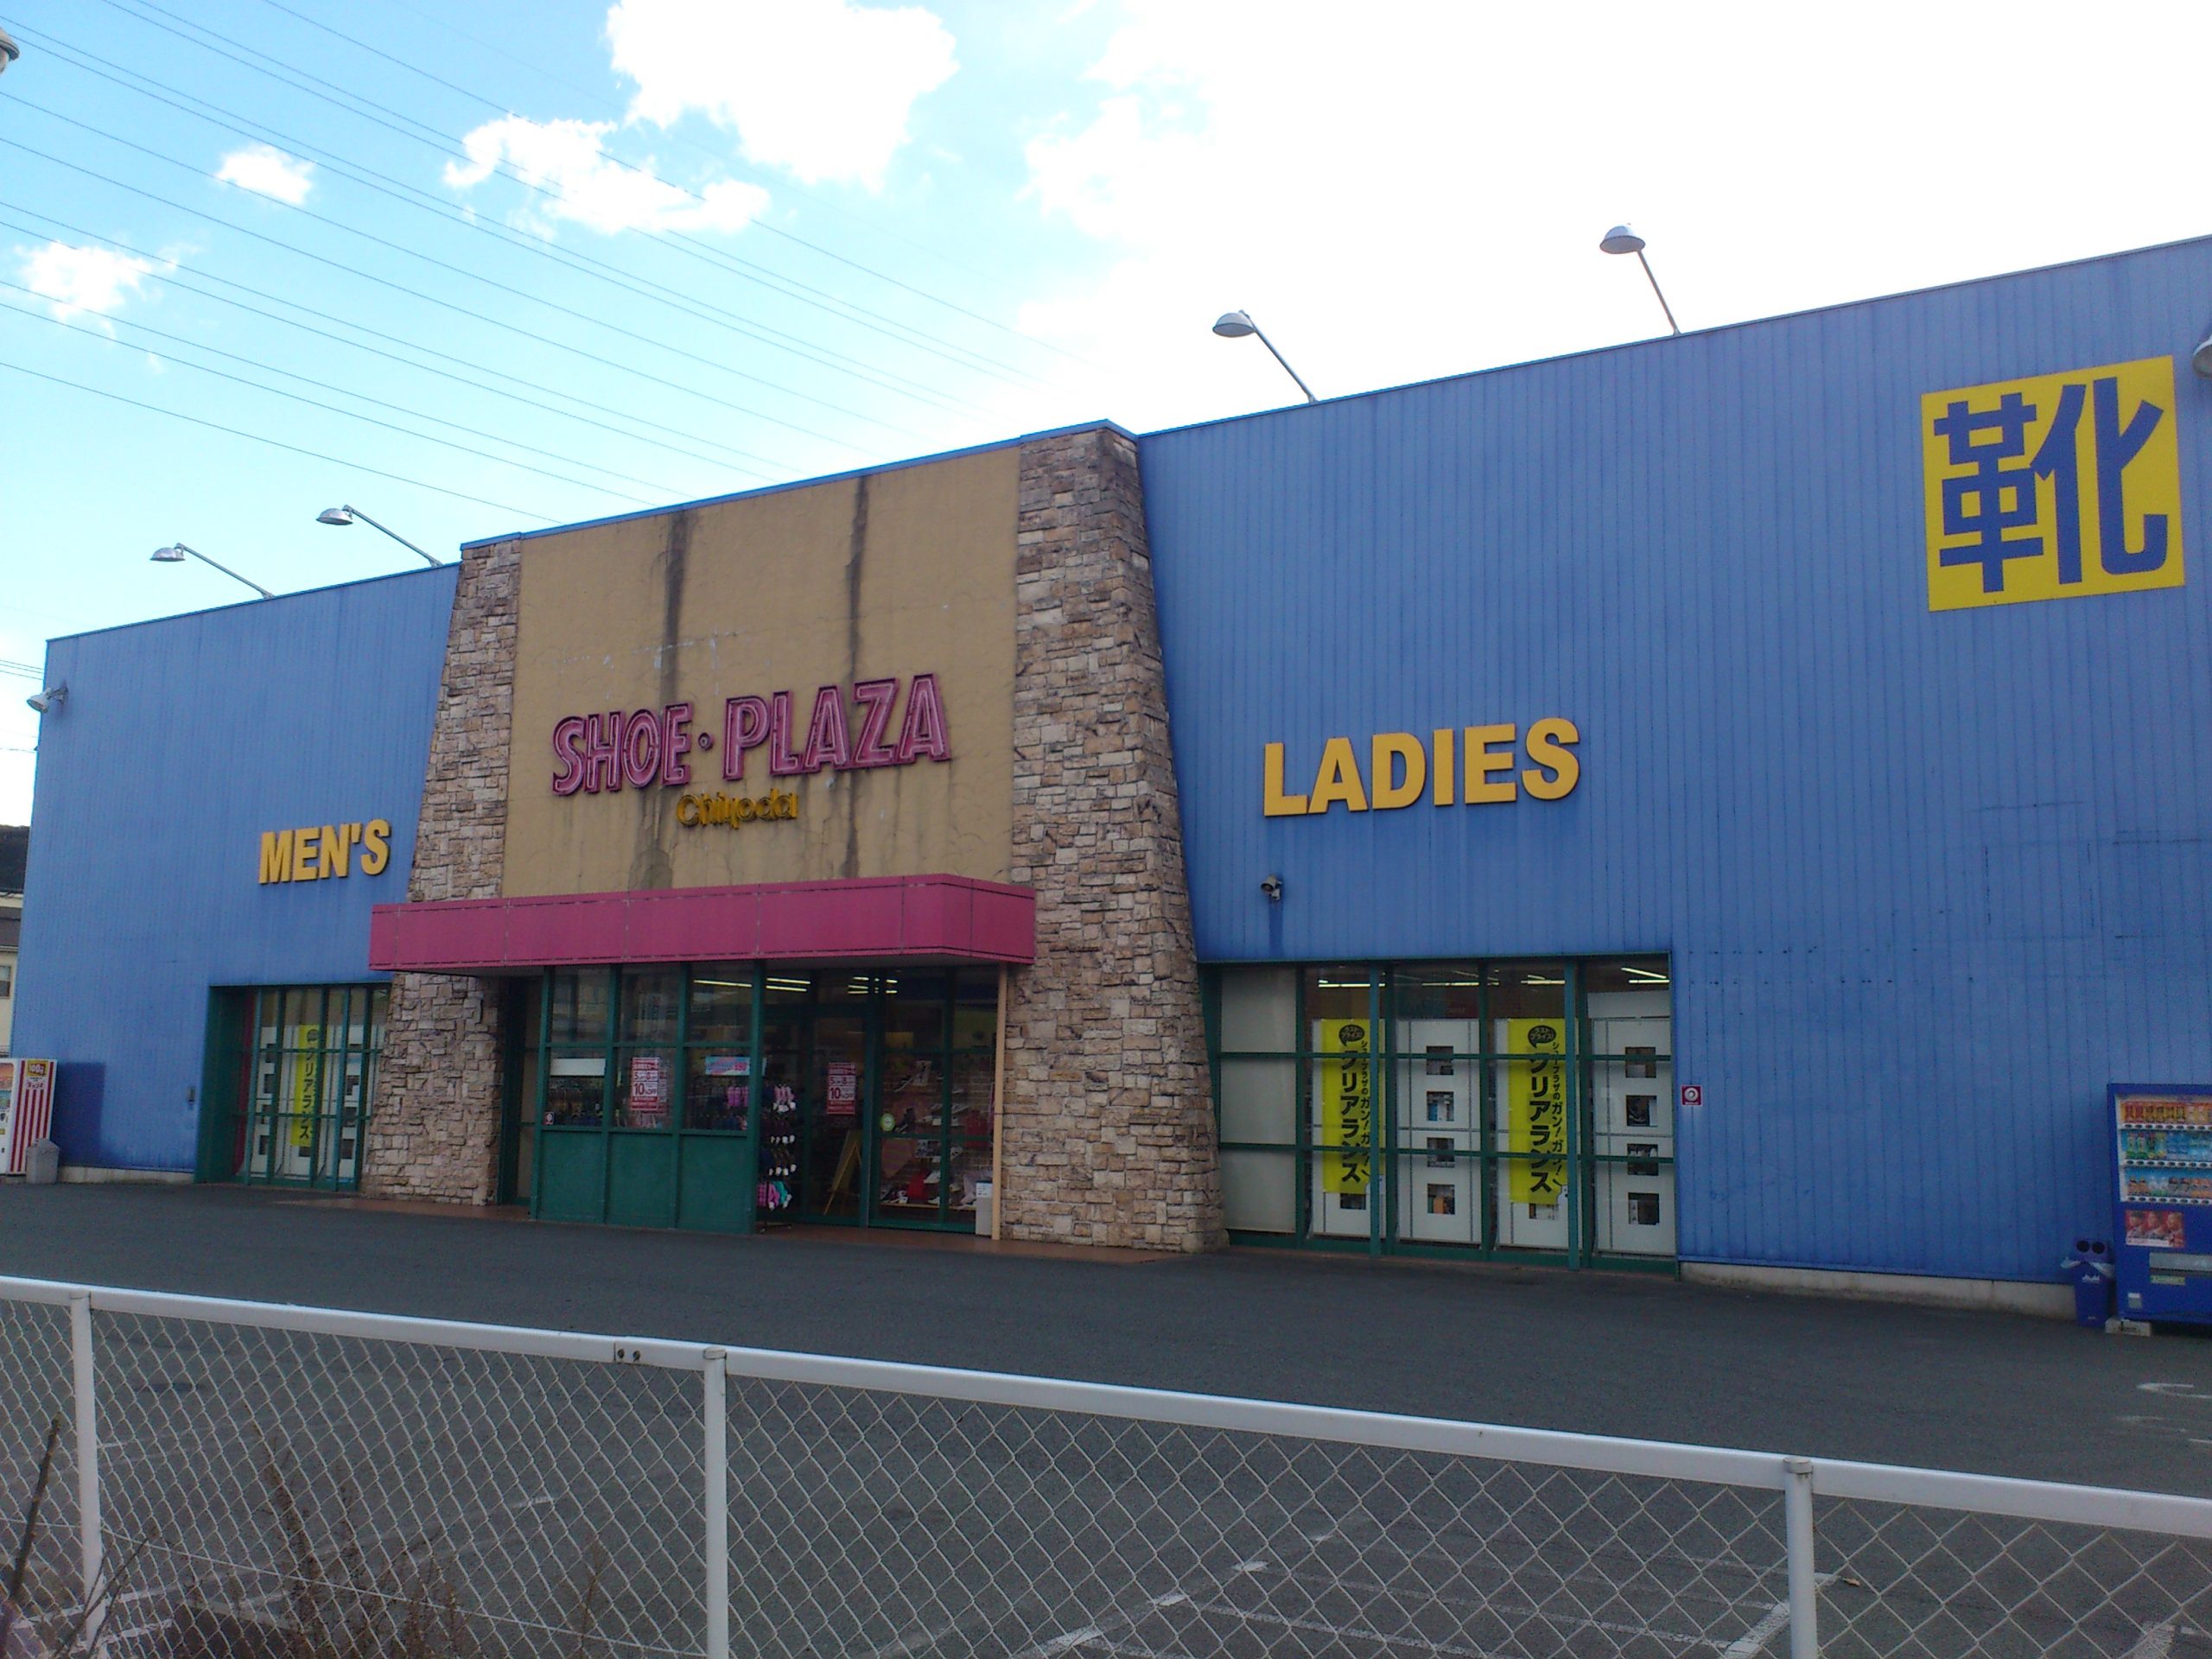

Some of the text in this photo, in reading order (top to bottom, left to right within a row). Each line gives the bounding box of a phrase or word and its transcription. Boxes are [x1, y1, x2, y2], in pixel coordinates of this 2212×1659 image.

[1934, 377, 2169, 594] 靴
[1263, 717, 1580, 817] LADIES
[258, 818, 392, 885] MEN'S
